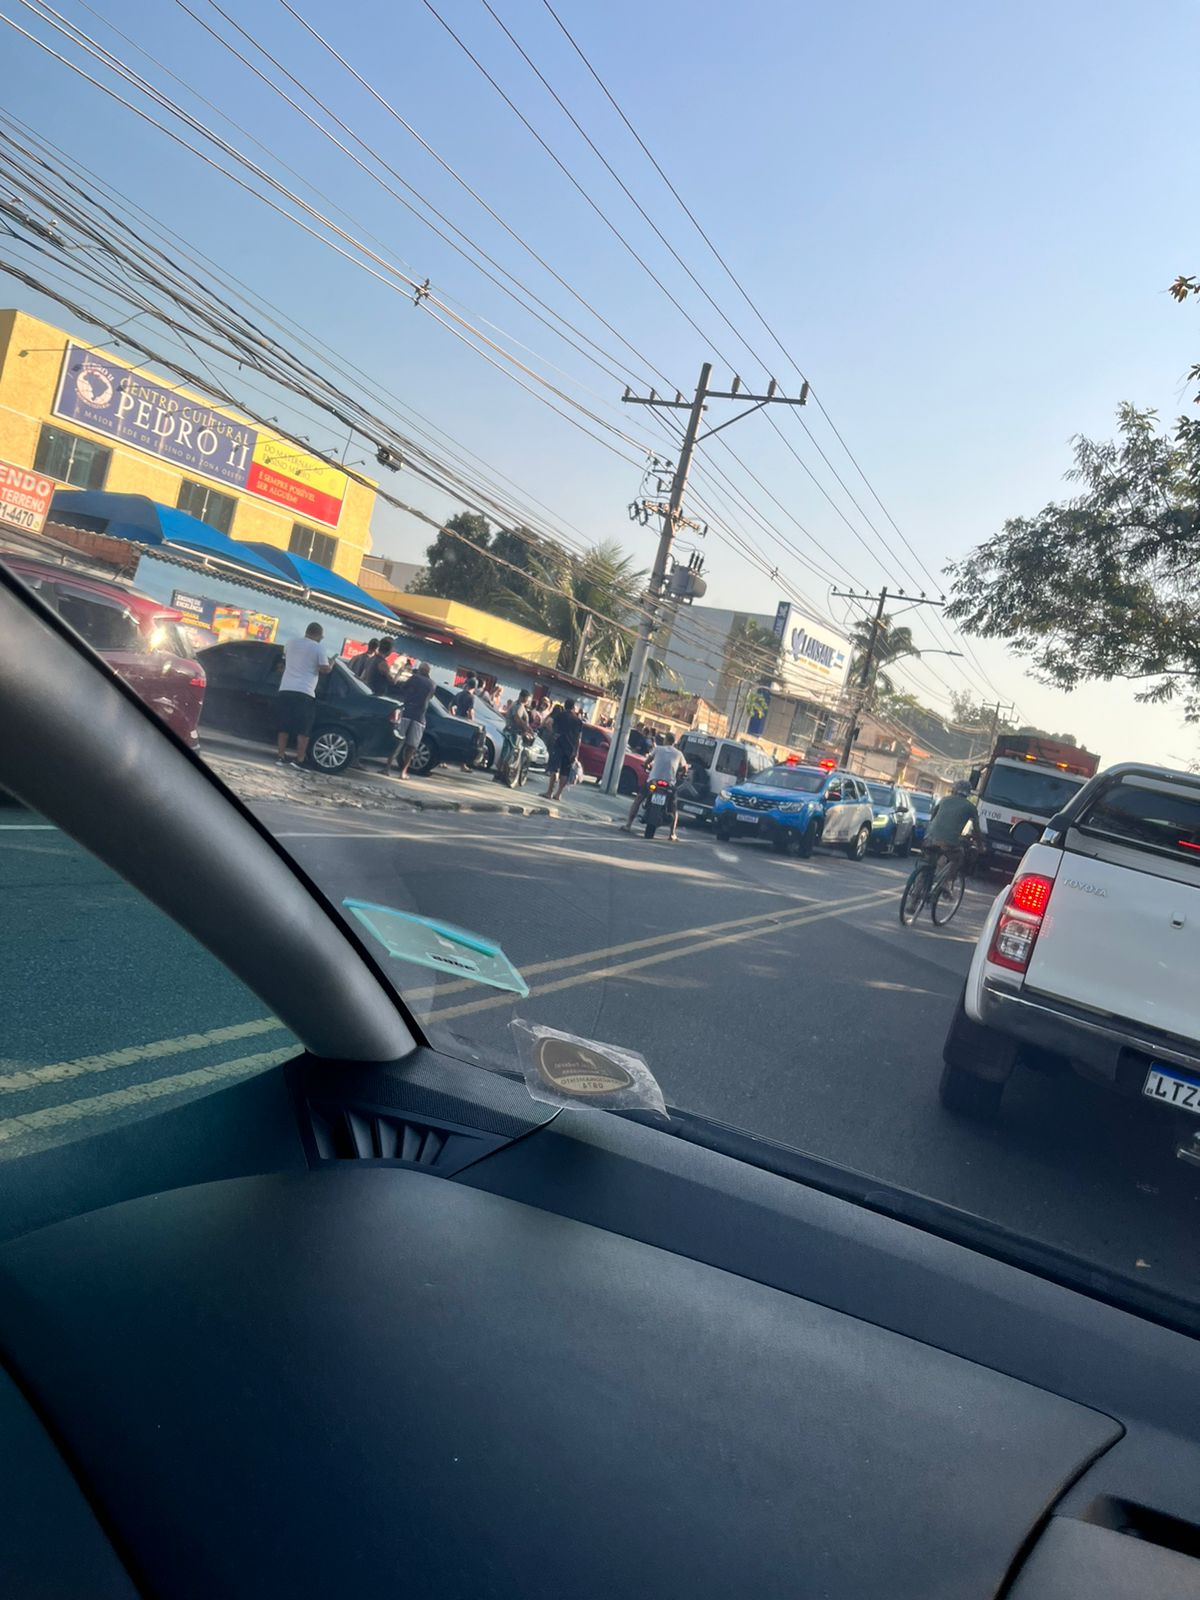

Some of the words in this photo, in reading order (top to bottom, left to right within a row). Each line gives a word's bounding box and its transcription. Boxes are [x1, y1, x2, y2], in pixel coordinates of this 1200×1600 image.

[85, 410, 113, 427] MAIOR
[120, 377, 178, 412] CENTRO
[182, 407, 249, 445] CULTURAL
[115, 391, 218, 455] PEDRO
[226, 440, 250, 471] II
[256, 481, 269, 492] SER
[1, 487, 45, 513] TERRENO
[1063, 879, 1106, 897] TOYOTA
[1154, 1076, 1200, 1108] LTZ
